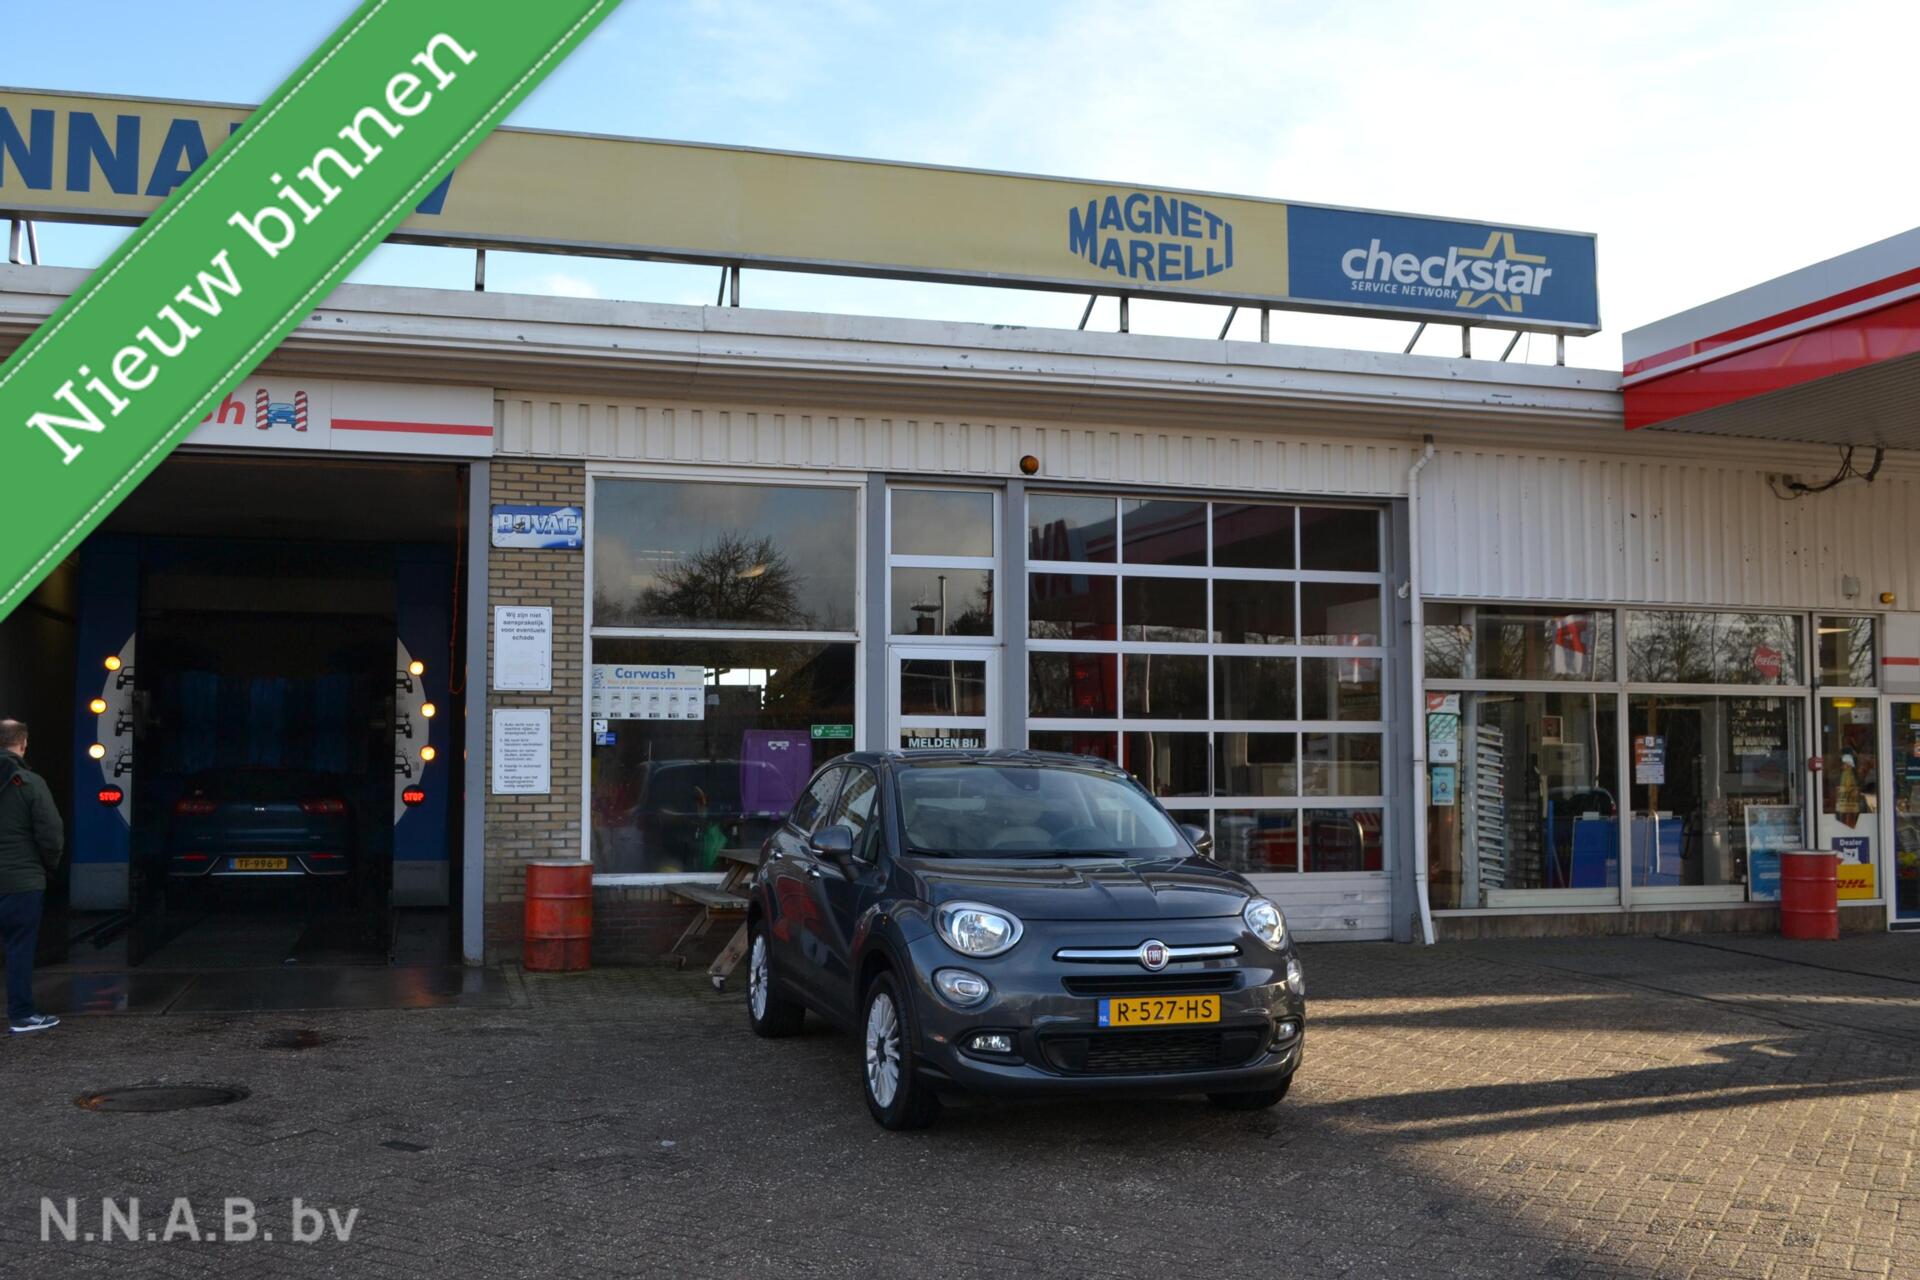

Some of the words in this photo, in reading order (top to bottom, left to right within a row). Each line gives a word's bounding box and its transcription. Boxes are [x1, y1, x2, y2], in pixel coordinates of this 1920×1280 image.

[0, 106, 250, 197] NNA
[1069, 193, 1233, 258] MAGNETI
[1069, 215, 1233, 282] MARELLI
[1341, 238, 1552, 296] checkstar
[1351, 280, 1398, 294] SERVICE
[1401, 285, 1459, 299] NETWORK
[615, 668, 676, 680] Carwash
[908, 738, 959, 748] MELDEN
[962, 739, 979, 748] BIJ
[98, 791, 121, 801] STOP
[403, 792, 425, 802] STOP
[1839, 839, 1863, 847] Dealer
[1836, 879, 1867, 889] DHL
[1148, 950, 1161, 962] FIAT
[1117, 999, 1213, 1022] R-527-HS
